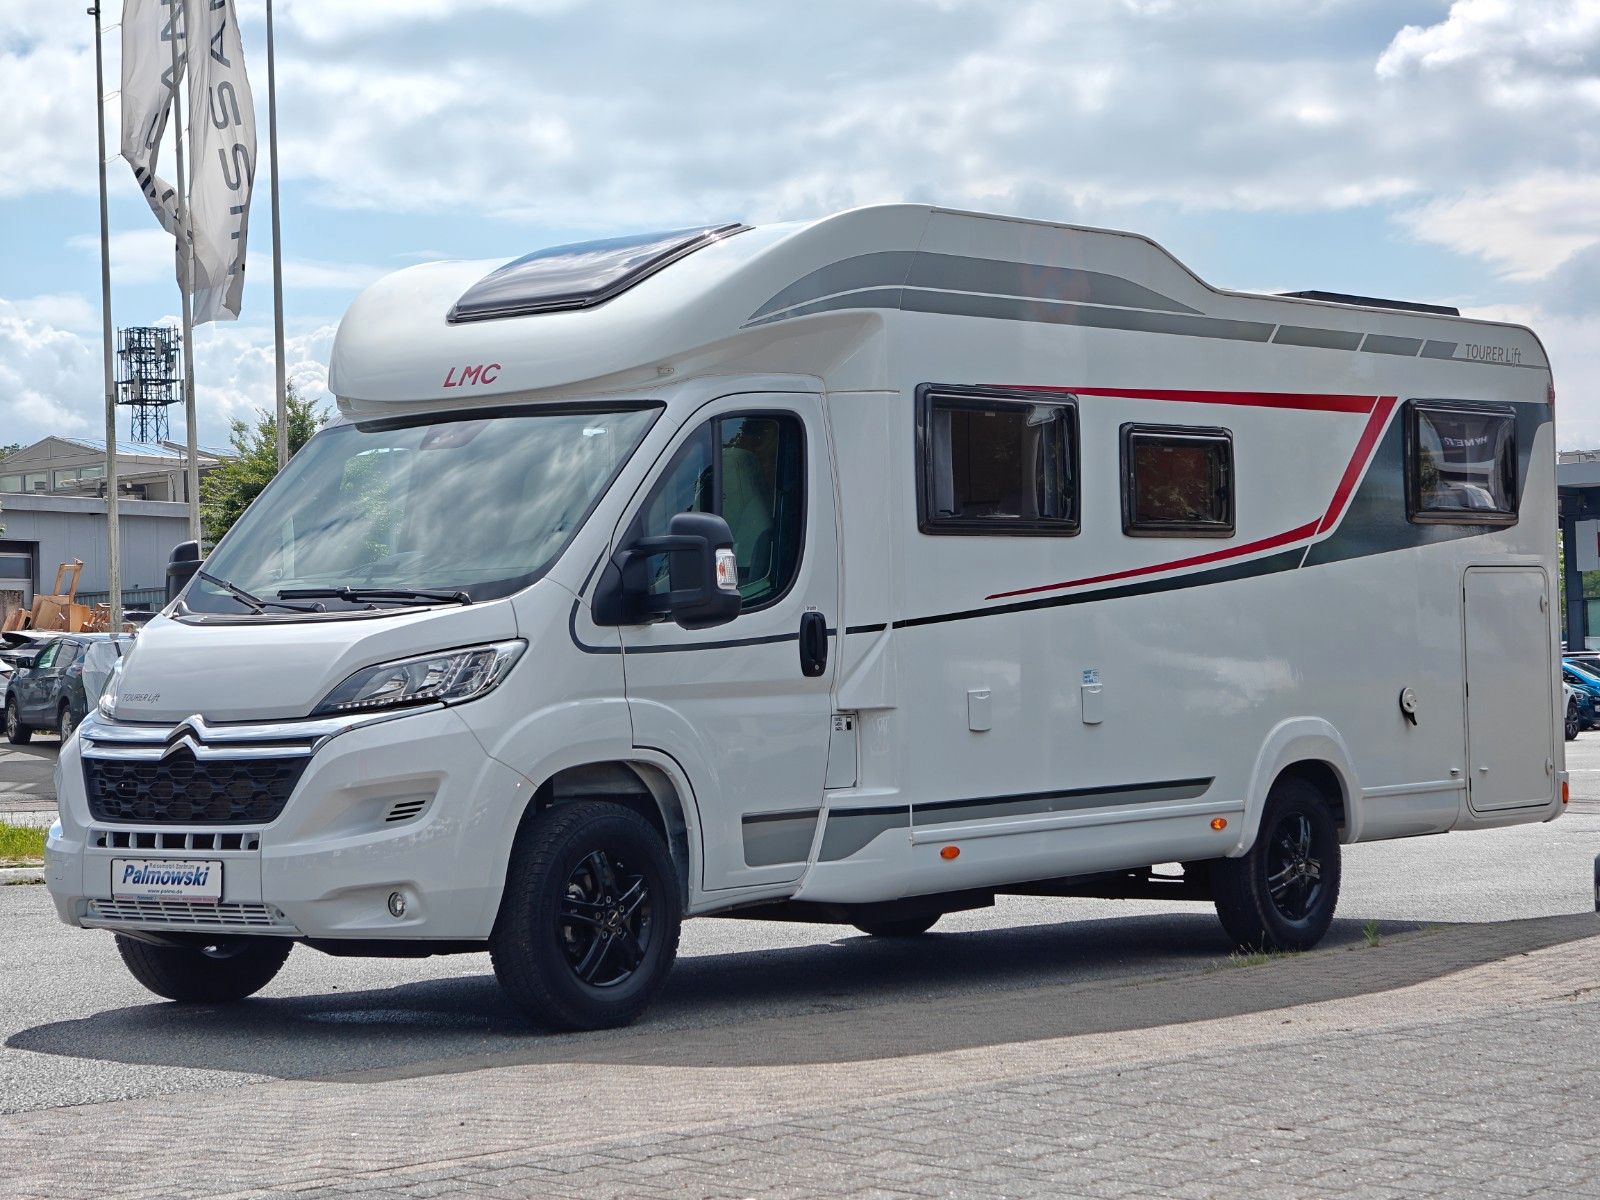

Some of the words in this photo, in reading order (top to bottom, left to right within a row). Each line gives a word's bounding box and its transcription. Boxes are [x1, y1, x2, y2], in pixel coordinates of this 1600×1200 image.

[1465, 343, 1504, 362] TOURER
[1505, 347, 1522, 368] Lift
[443, 363, 502, 388] LMC
[122, 864, 210, 886] Palmowski
